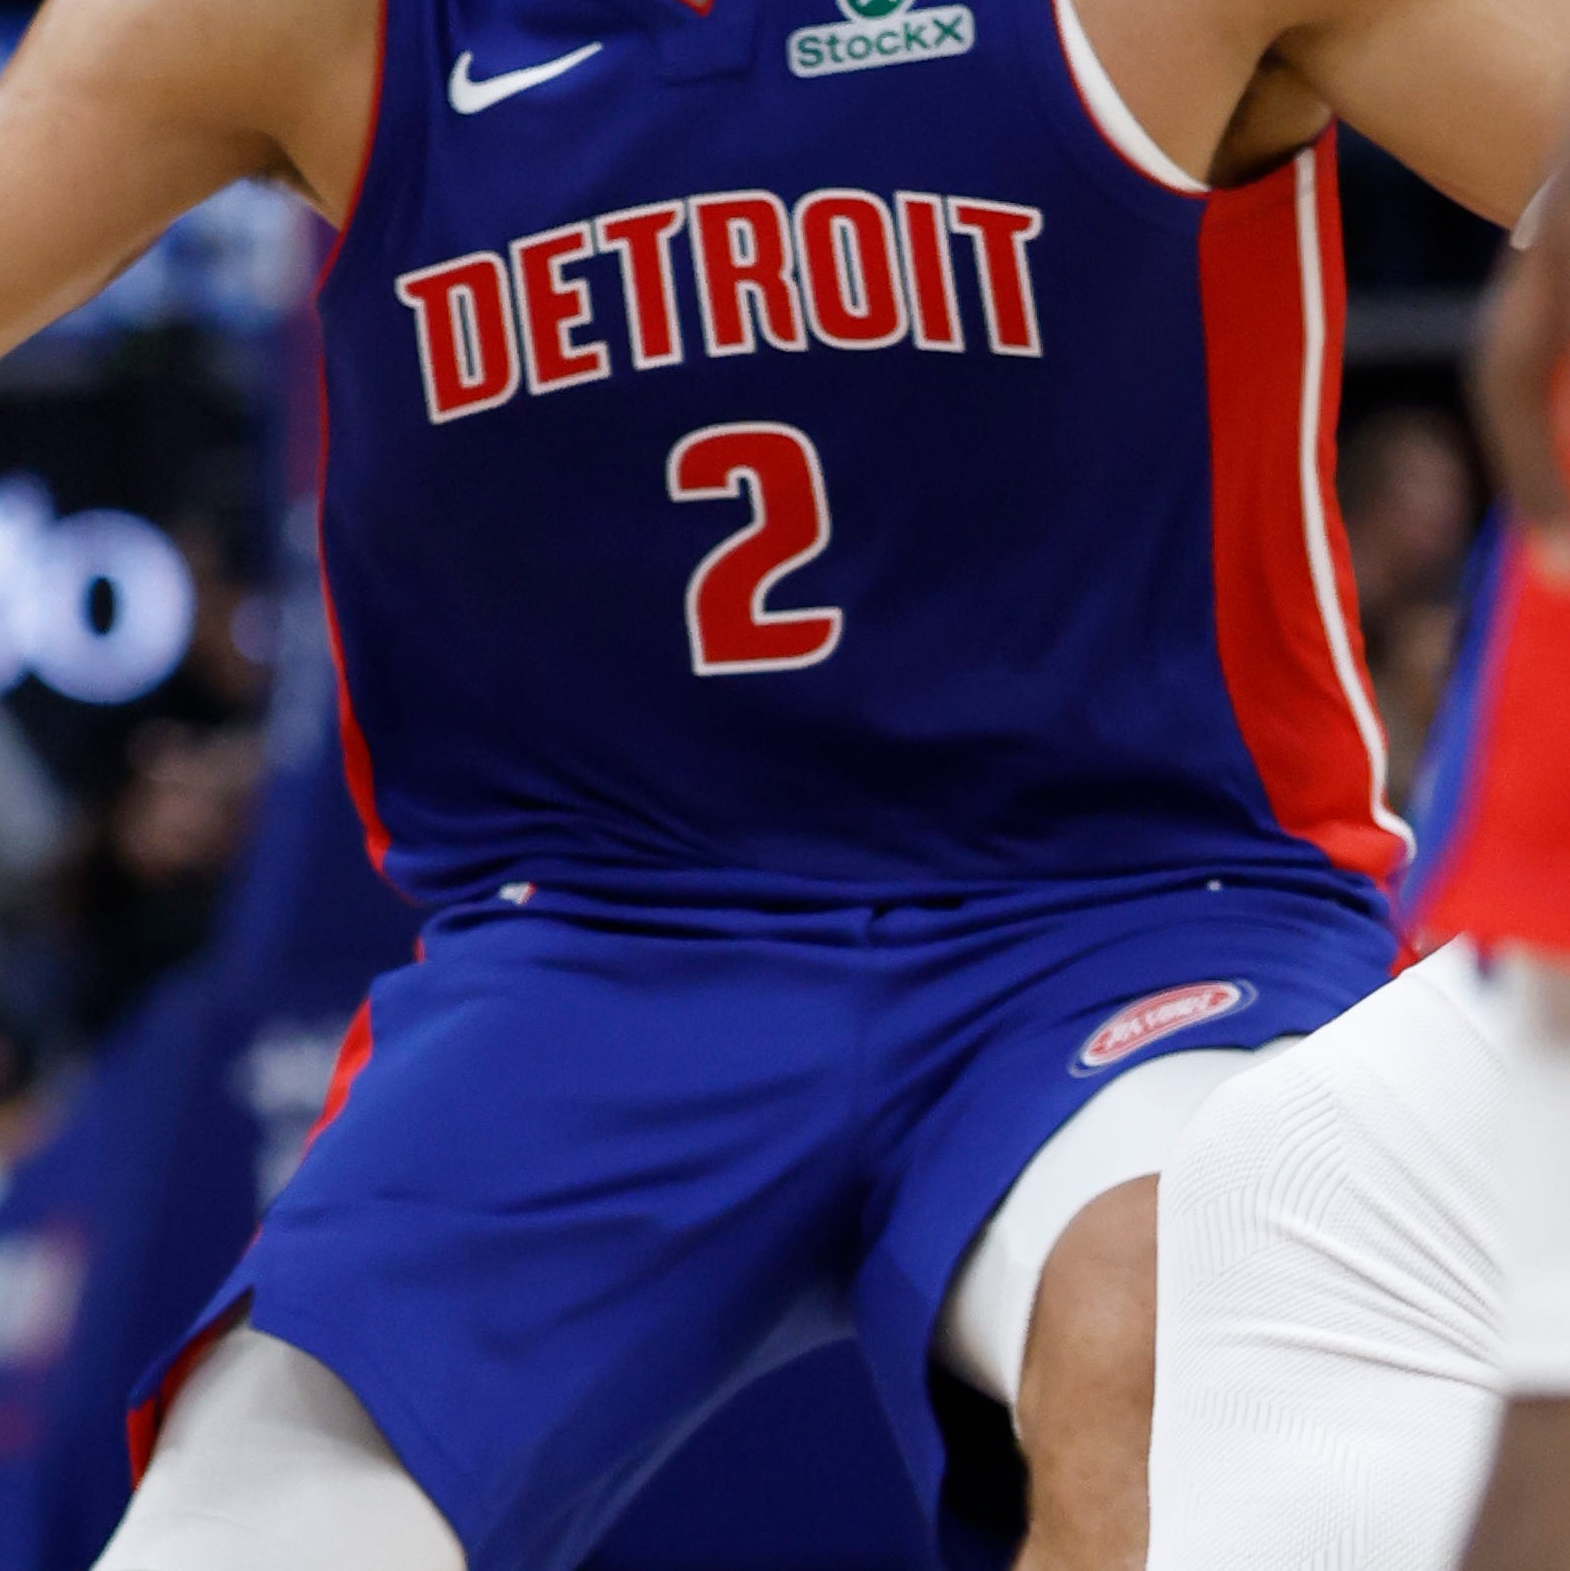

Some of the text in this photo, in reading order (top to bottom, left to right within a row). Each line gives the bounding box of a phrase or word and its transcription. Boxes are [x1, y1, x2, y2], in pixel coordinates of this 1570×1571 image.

[797, 13, 964, 68] StockX
[395, 188, 1044, 425] DETROIT
[666, 421, 844, 677] 2
